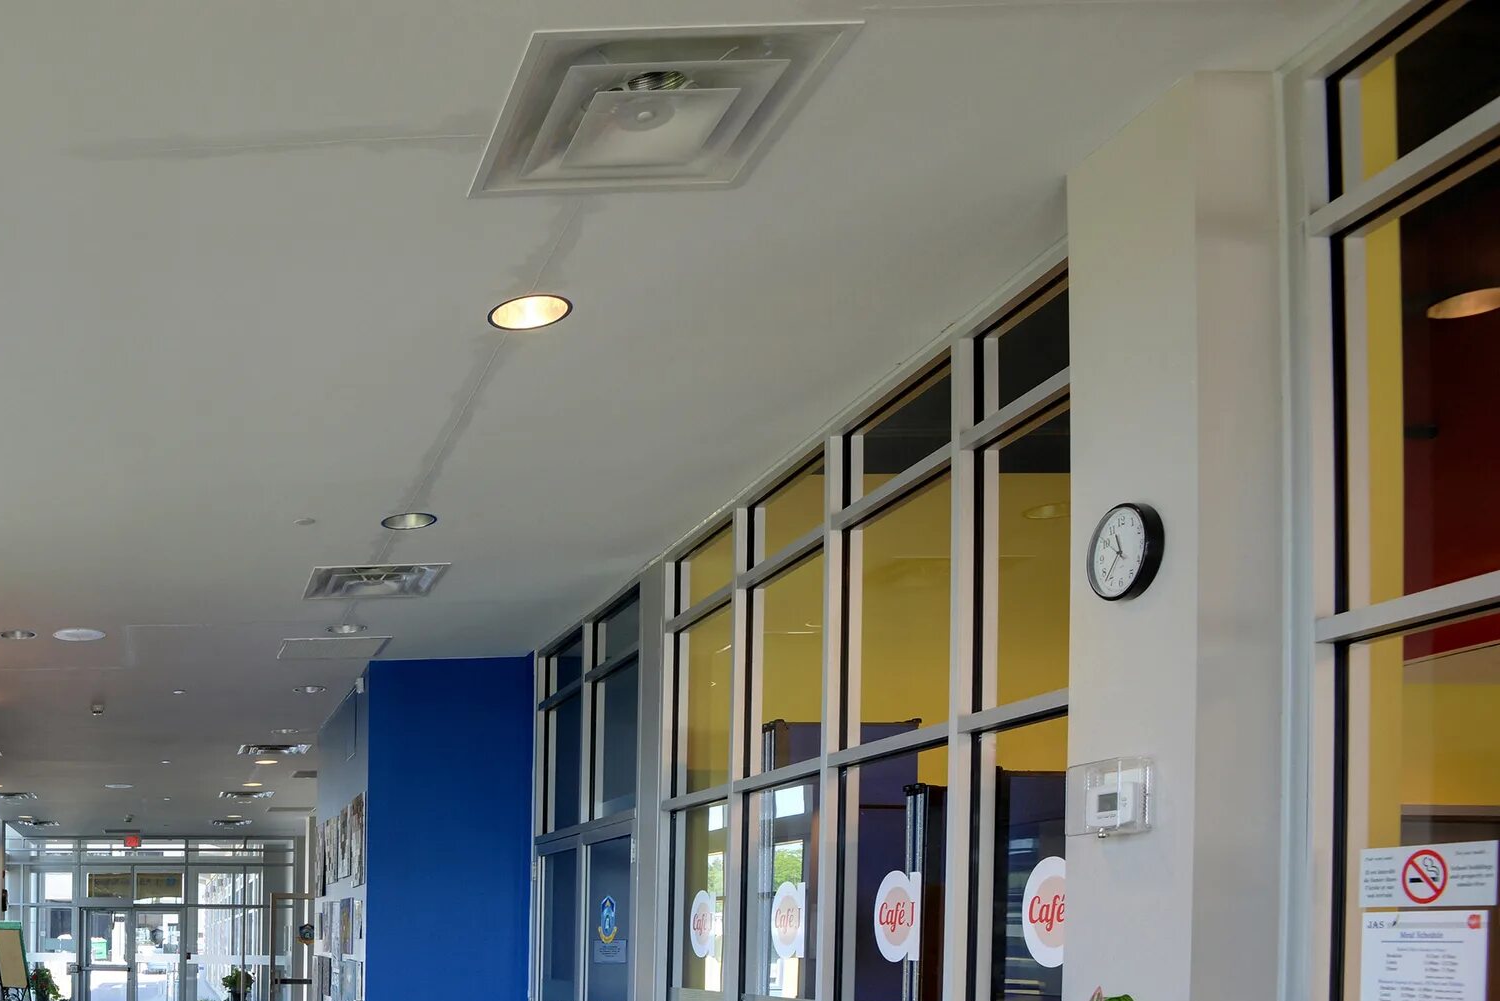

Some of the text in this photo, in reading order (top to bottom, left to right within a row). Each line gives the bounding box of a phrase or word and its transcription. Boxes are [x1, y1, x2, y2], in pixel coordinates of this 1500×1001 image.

[1109, 525, 1115, 535] 11
[1117, 516, 1125, 527] 12
[1103, 538, 1110, 549] 10
[692, 912, 707, 936] Café
[774, 907, 801, 934] Café J
[879, 901, 915, 932] Café J
[1028, 894, 1065, 932] Café
